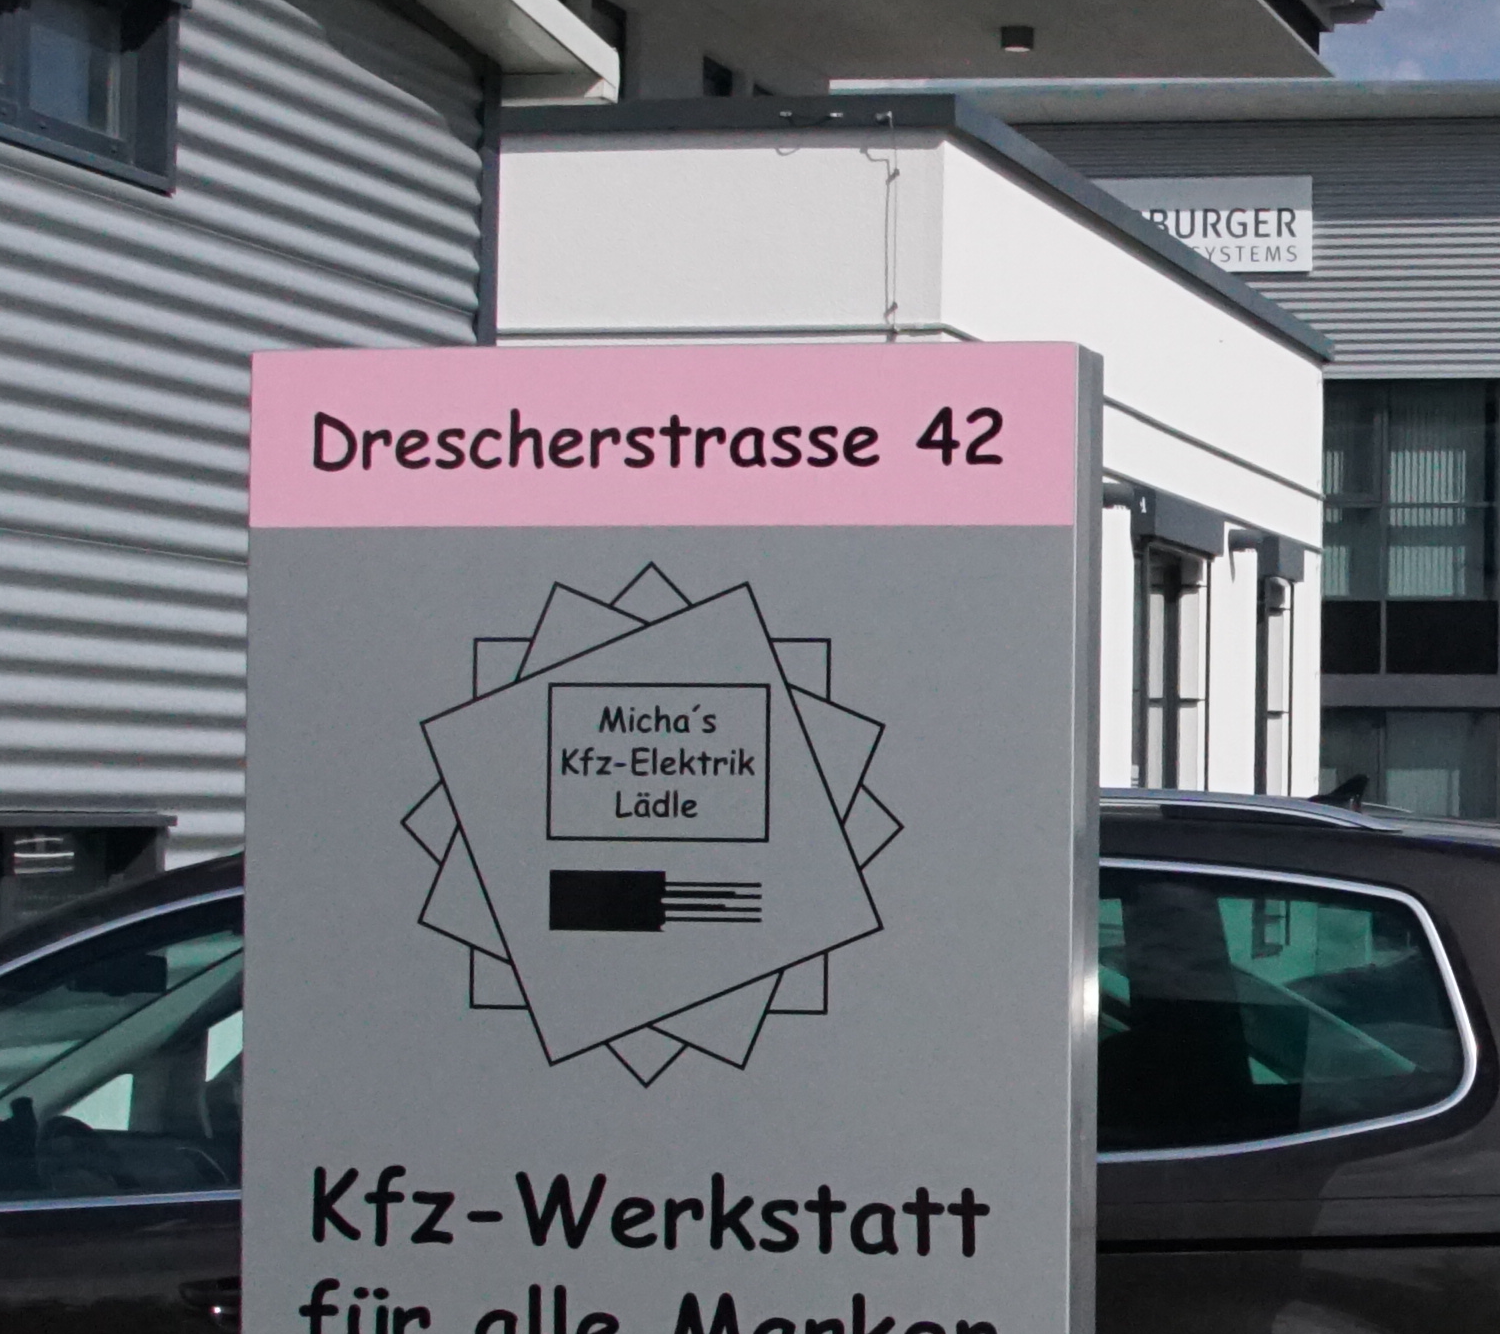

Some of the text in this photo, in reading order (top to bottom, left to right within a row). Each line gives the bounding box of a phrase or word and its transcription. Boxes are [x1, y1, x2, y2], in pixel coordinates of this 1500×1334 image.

[1134, 207, 1297, 239] BURGER
[312, 406, 1005, 472] Drescherstrasse 42
[560, 746, 756, 778] Kfz-Elektrik
[614, 789, 699, 820] Lädle
[311, 1164, 991, 1258] Kfz-Werkstatt
